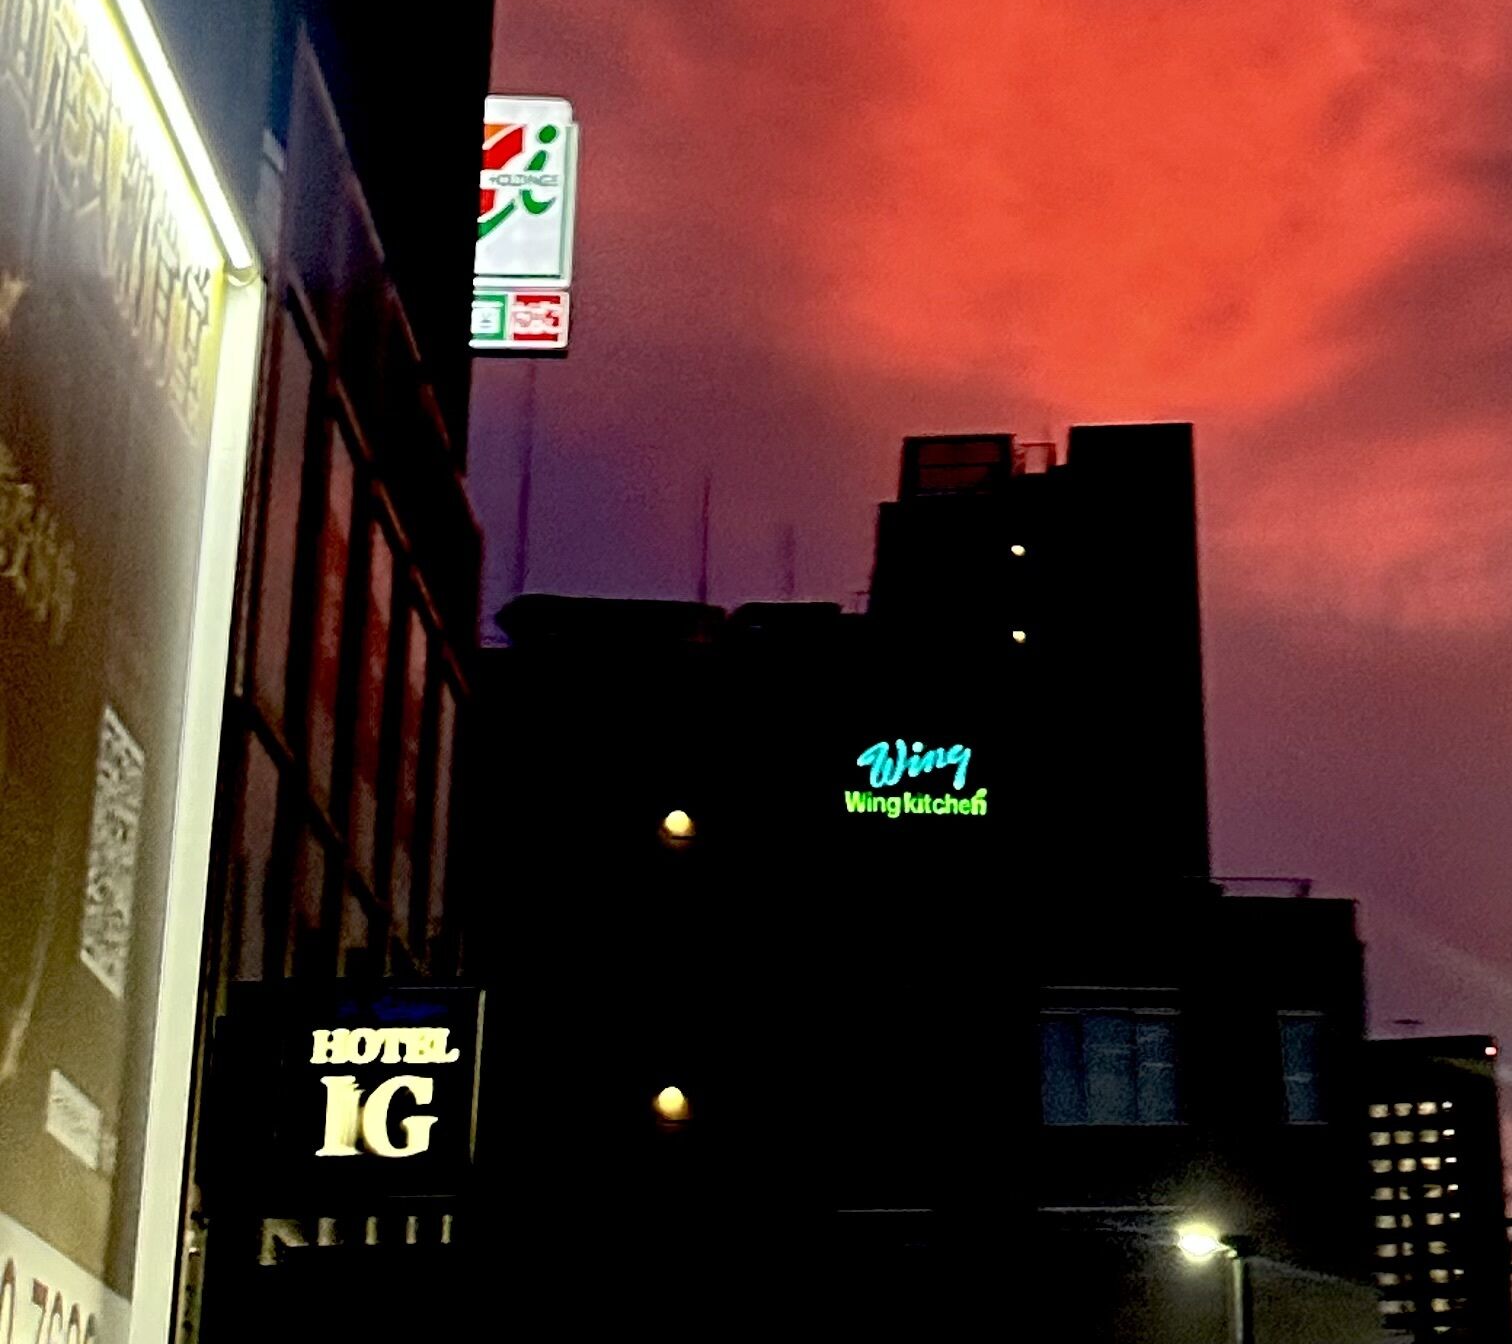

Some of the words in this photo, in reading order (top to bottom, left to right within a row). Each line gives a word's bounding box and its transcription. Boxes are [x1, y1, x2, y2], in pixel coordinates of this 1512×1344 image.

[856, 738, 972, 791] Wing
[845, 790, 902, 819] Wing
[903, 787, 988, 816] kitchen
[309, 1026, 461, 1065] HOTEL
[314, 1074, 439, 1158] IG
